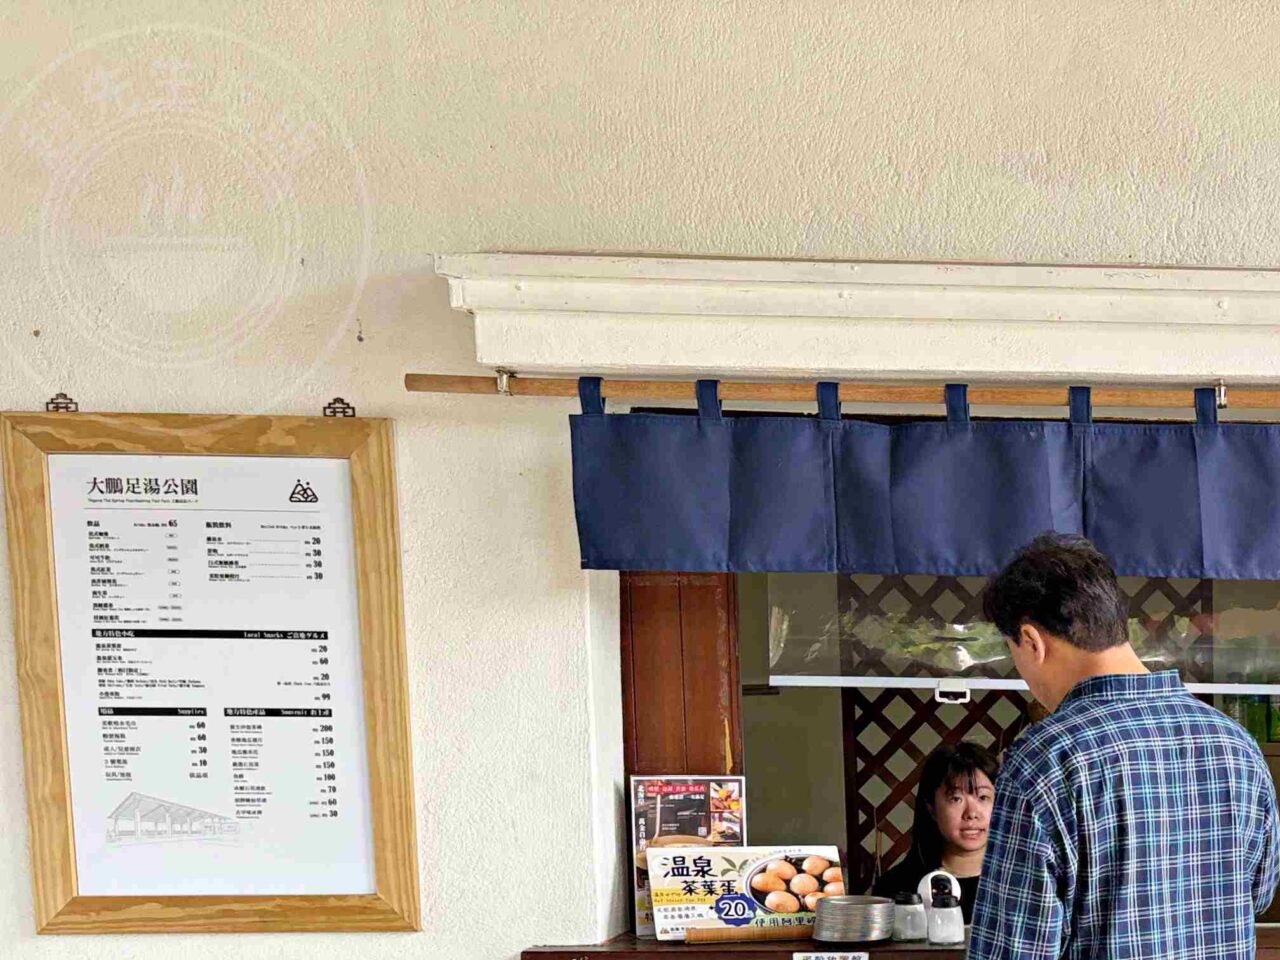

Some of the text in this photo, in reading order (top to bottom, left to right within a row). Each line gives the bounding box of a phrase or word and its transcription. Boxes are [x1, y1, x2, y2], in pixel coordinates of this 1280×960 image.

[86, 476, 199, 496] 大鵬足湯公園
[168, 519, 178, 528] 65
[311, 537, 321, 545] 20
[312, 549, 322, 557] 30
[313, 560, 322, 568] 30
[314, 572, 323, 580] 30
[318, 645, 328, 653] 20
[319, 657, 329, 665] 60
[320, 673, 329, 681] 20
[321, 693, 331, 701] 99
[196, 721, 206, 729] 60
[319, 724, 333, 732] 200
[197, 733, 207, 741] 60
[321, 737, 334, 745] 150
[198, 746, 208, 754] 30
[322, 749, 334, 757] 150
[199, 759, 208, 767] 10
[323, 761, 335, 769] 150
[323, 773, 336, 781] 100
[327, 798, 337, 806] 60
[329, 810, 338, 818] 30
[681, 879, 738, 897] 茶葉蛋
[720, 901, 747, 918] 20
